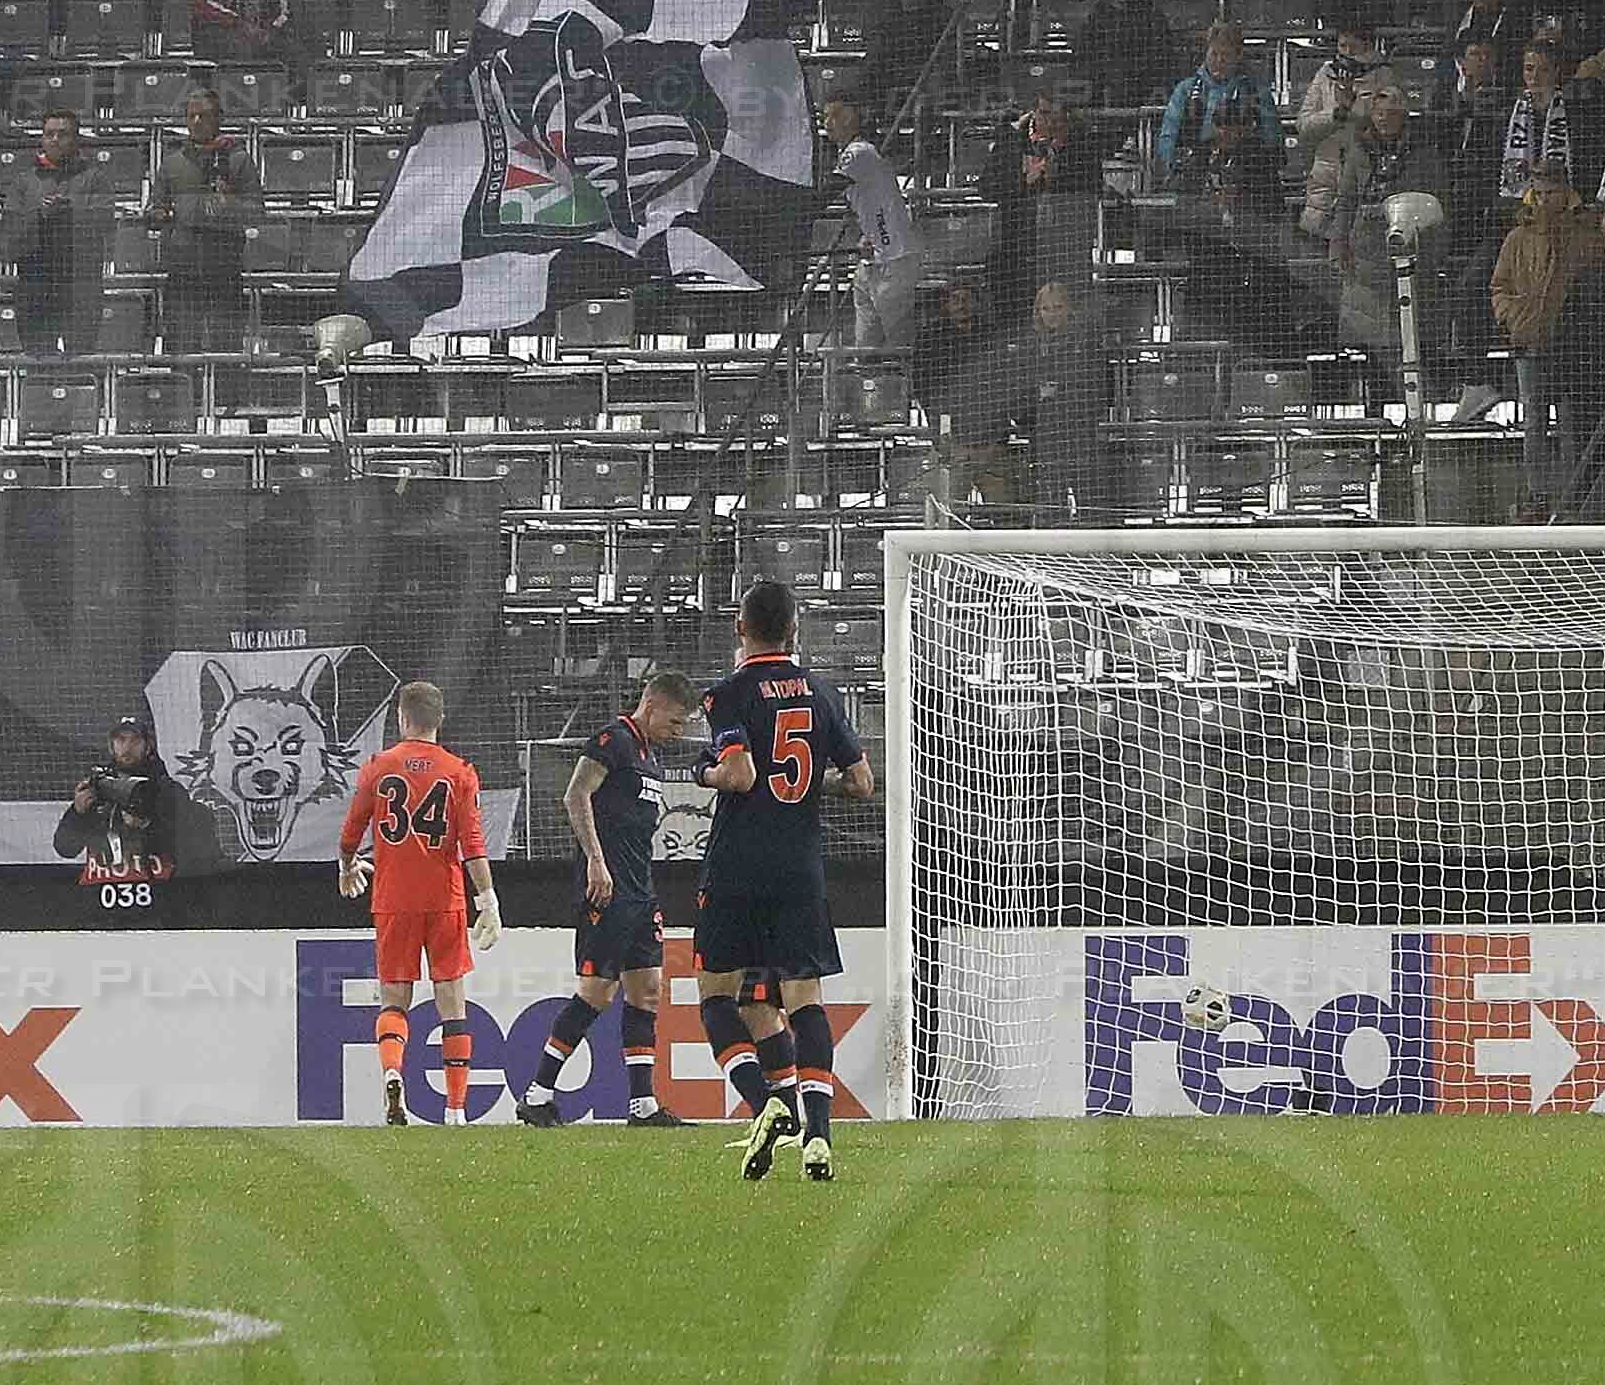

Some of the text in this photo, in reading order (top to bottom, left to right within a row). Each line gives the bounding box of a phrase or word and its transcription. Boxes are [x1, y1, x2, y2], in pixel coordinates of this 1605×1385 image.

[767, 707, 813, 804] 5
[377, 774, 450, 850] 34
[99, 883, 153, 909] 038
